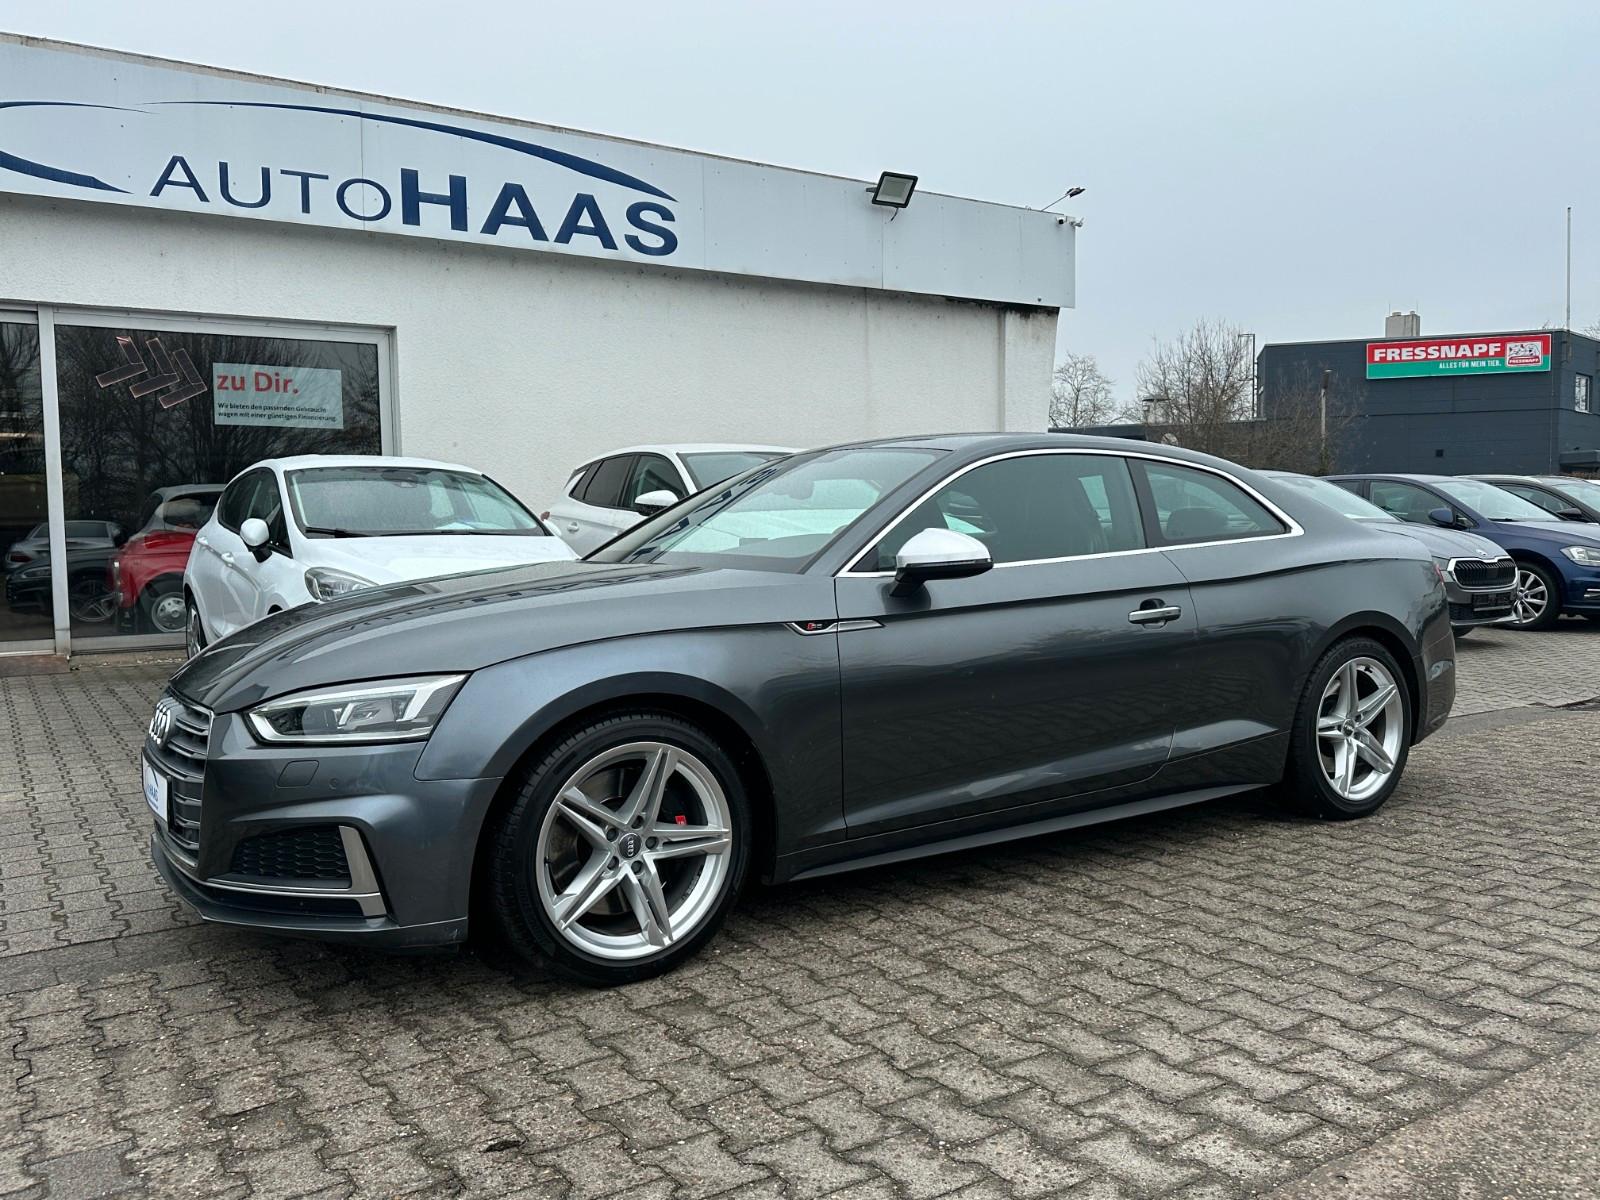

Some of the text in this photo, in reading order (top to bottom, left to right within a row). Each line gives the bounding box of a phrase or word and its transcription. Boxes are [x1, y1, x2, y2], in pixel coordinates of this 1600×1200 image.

[1373, 343, 1502, 362] FRESSNAPF
[1471, 360, 1486, 368] MEIN
[216, 371, 299, 395] zu Dir.
